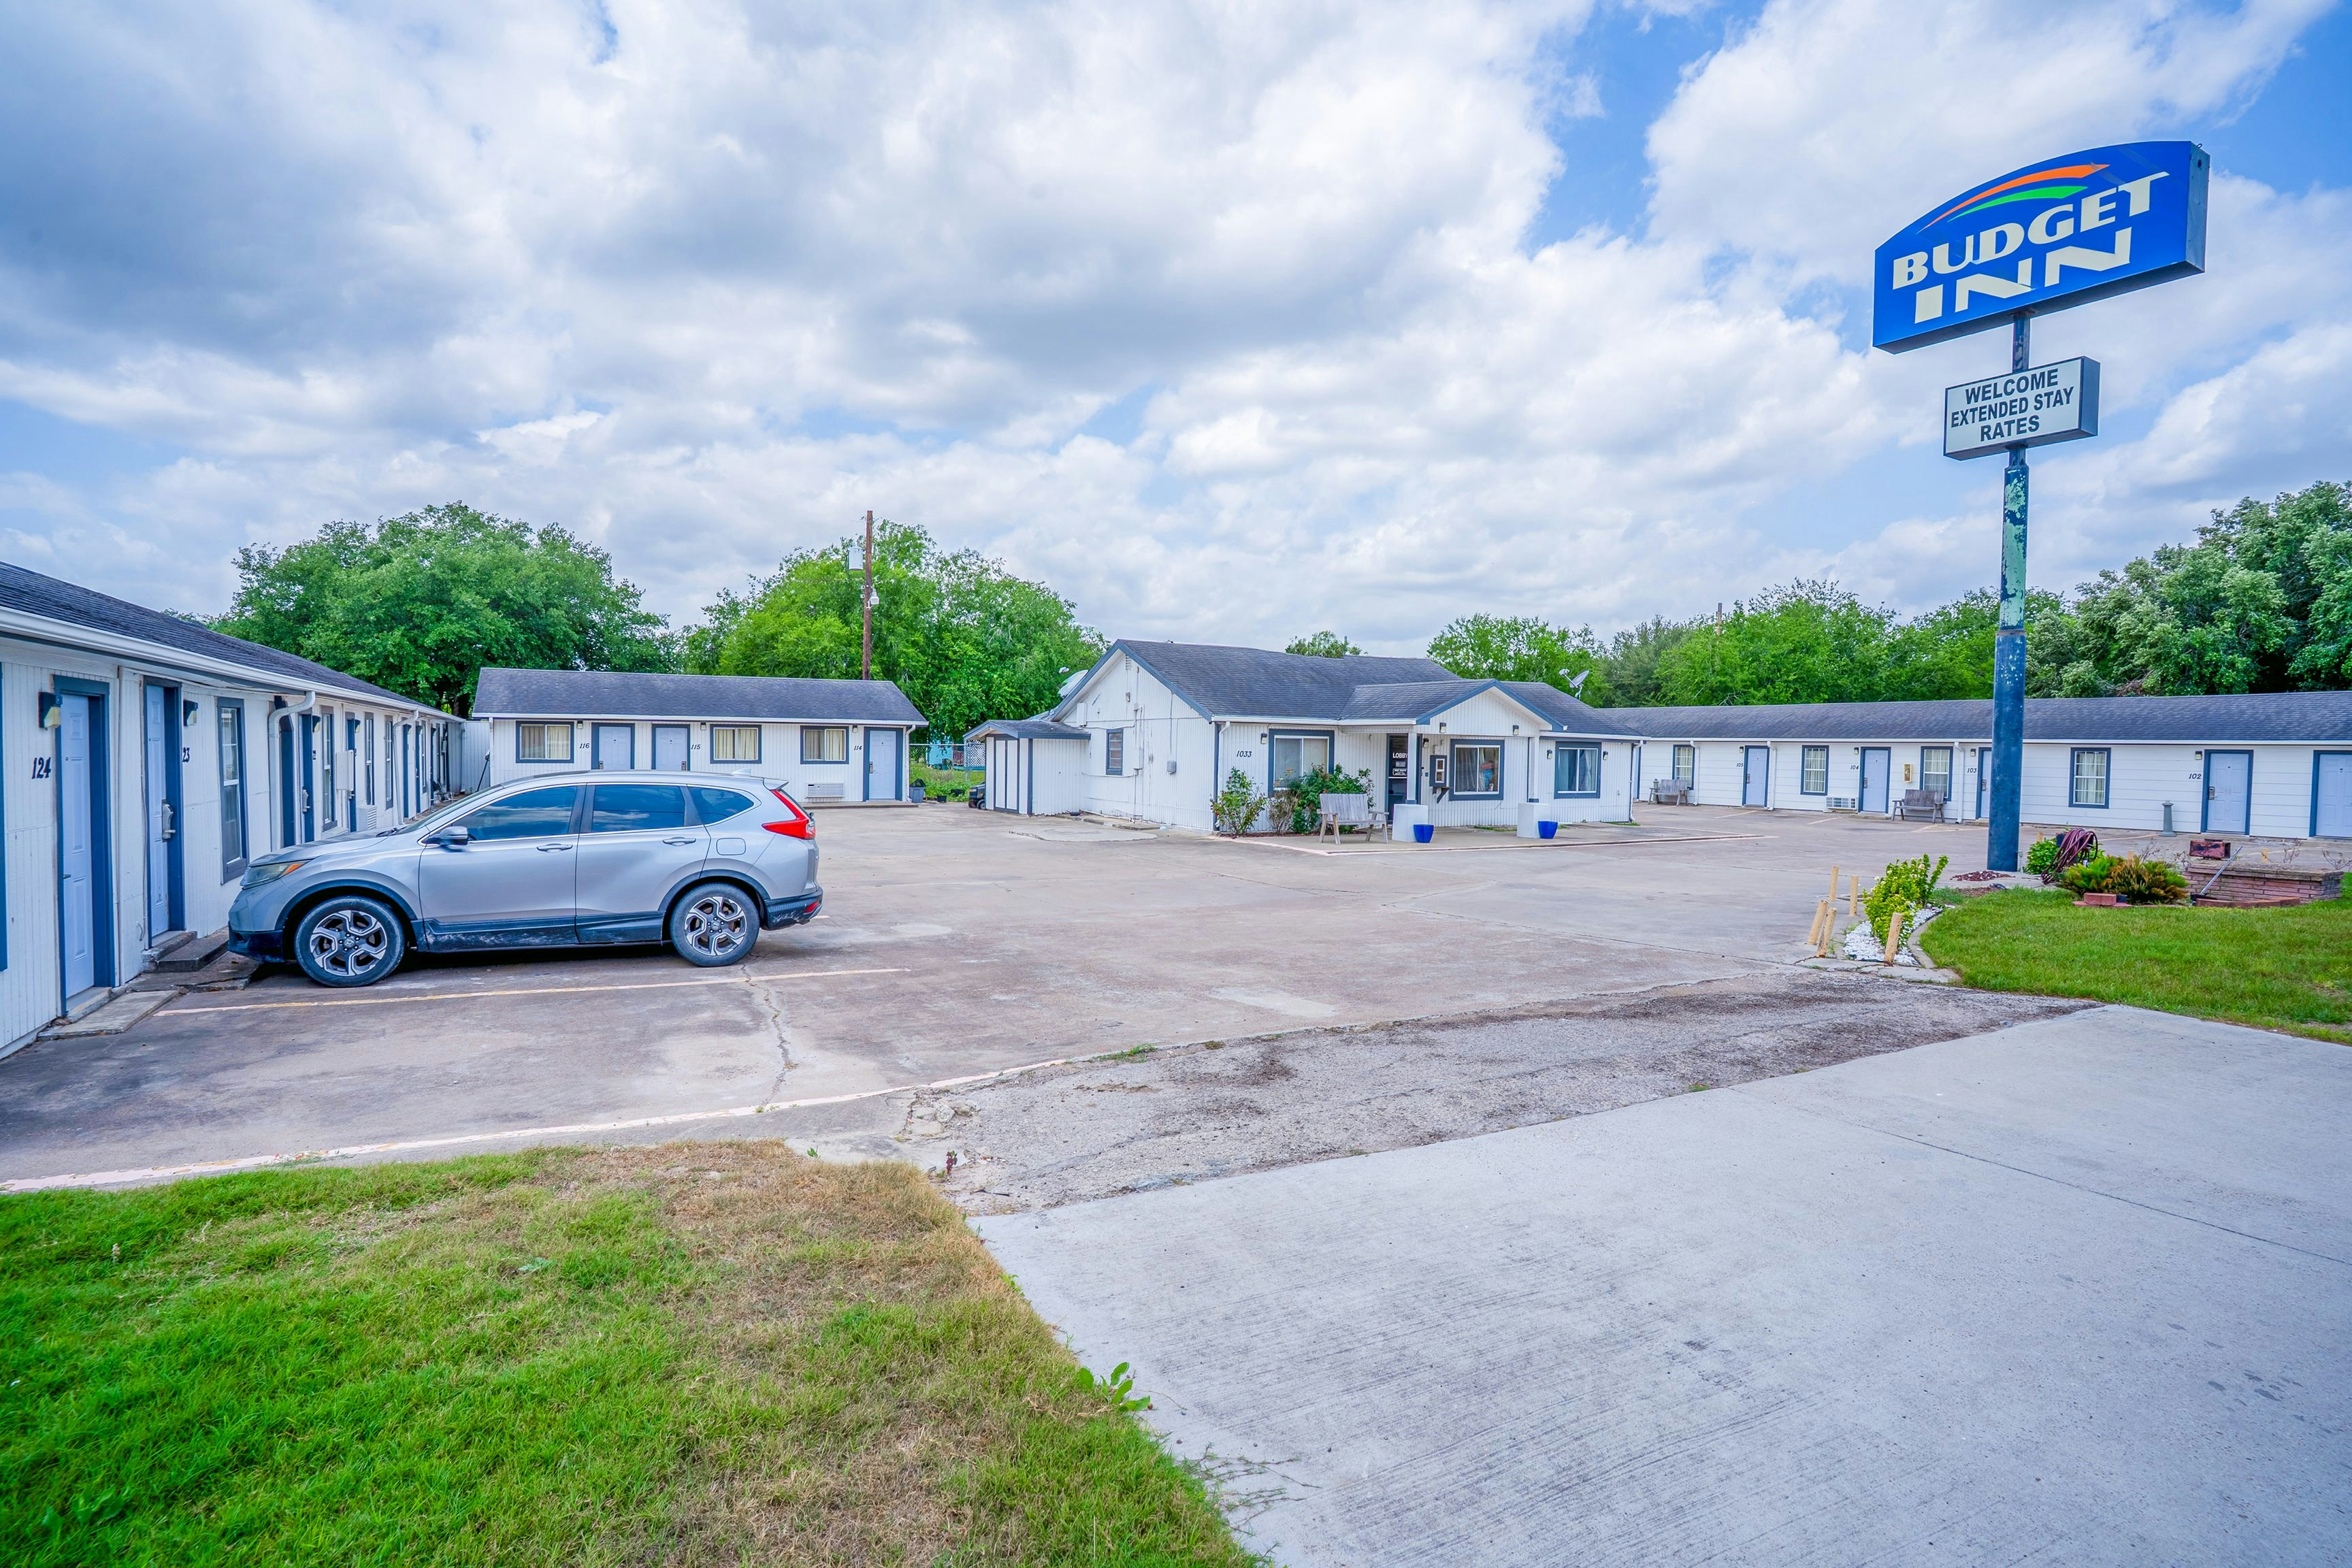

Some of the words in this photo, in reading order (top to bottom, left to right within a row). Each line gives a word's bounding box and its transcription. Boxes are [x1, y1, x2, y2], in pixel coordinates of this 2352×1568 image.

[1893, 172, 2170, 290] BUDGET
[1914, 226, 2132, 324] INN
[1965, 368, 2059, 405] WELCOME
[1950, 397, 2029, 428] EXTENDED
[2034, 386, 2074, 411] STAY
[1980, 414, 2040, 442] RATES
[31, 757, 52, 779] 124
[182, 747, 190, 763] 23
